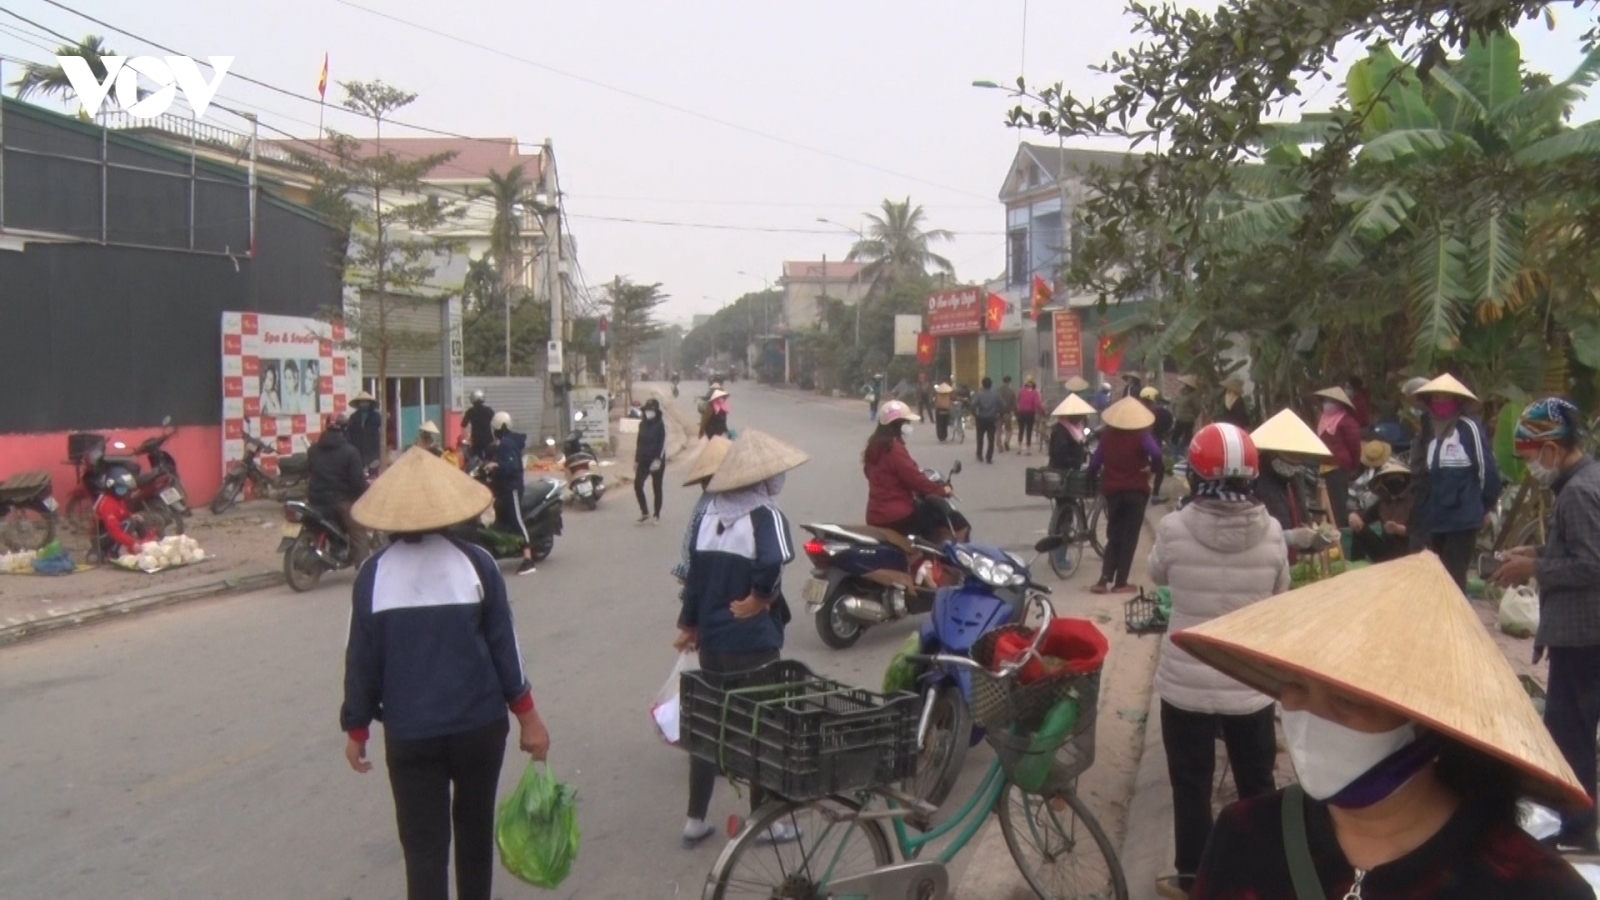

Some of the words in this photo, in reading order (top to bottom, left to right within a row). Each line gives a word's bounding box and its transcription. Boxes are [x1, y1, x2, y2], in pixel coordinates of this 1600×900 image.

[264, 331, 280, 344] Spa
[282, 332, 289, 344] &
[290, 332, 315, 345] Studio
